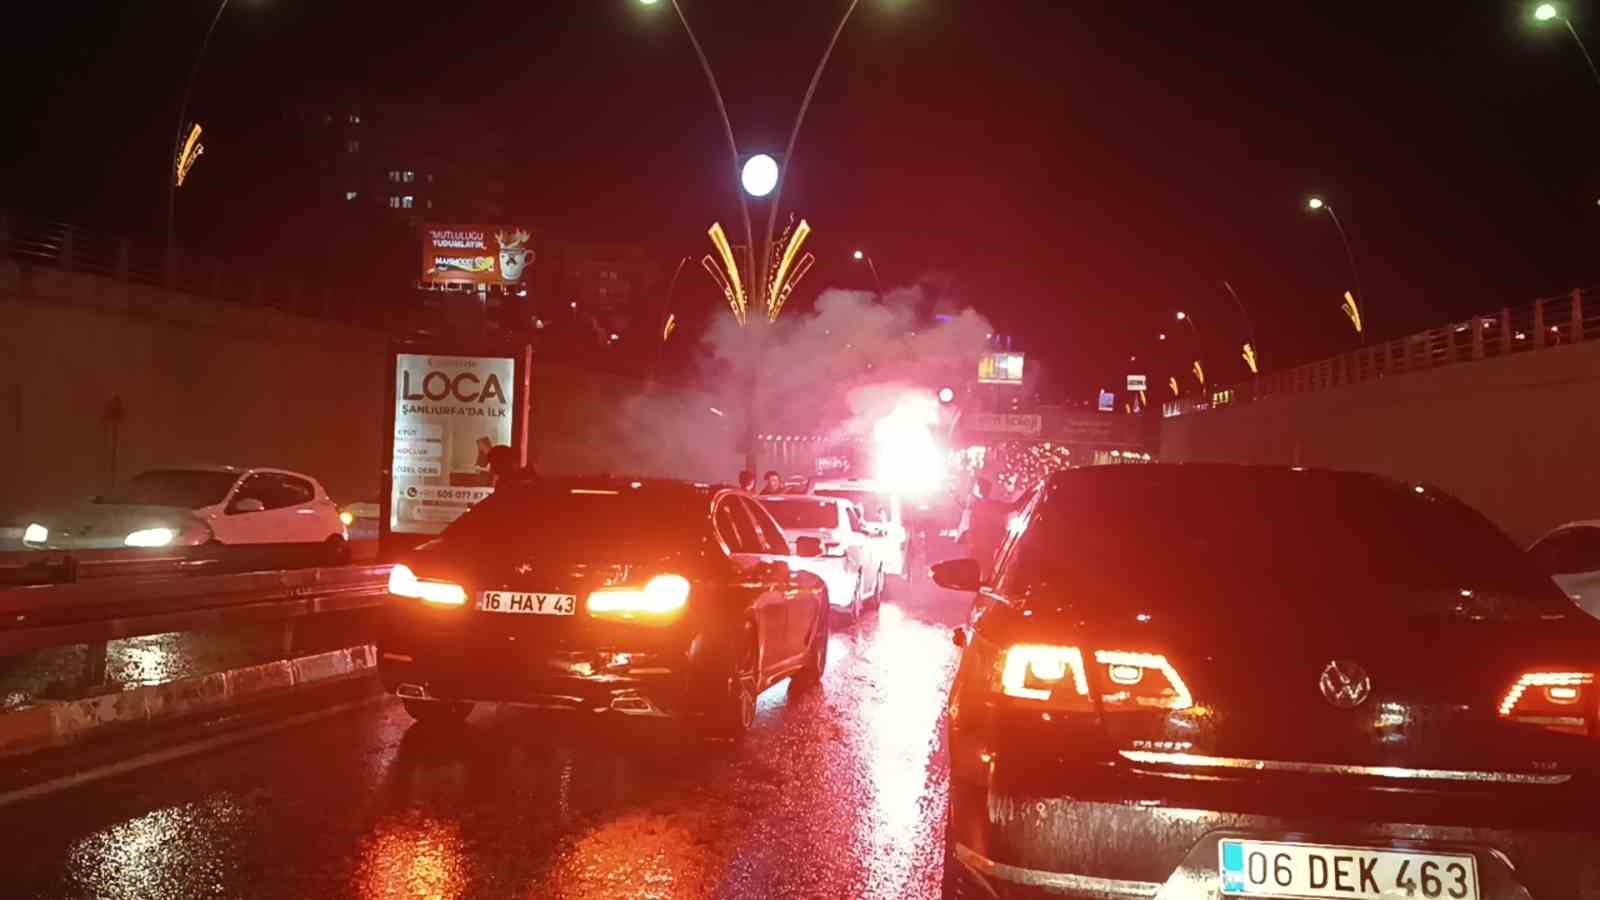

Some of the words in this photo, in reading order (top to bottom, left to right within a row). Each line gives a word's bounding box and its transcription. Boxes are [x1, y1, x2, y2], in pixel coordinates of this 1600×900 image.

[402, 370, 506, 403] LOCA
[402, 404, 484, 416] ŞANLIURFA'DA
[485, 593, 501, 610] 16
[510, 594, 547, 611] HAY
[553, 597, 575, 613] 43
[1248, 851, 1293, 887] 06
[1308, 854, 1381, 894] DEK
[1396, 859, 1468, 899] 463
